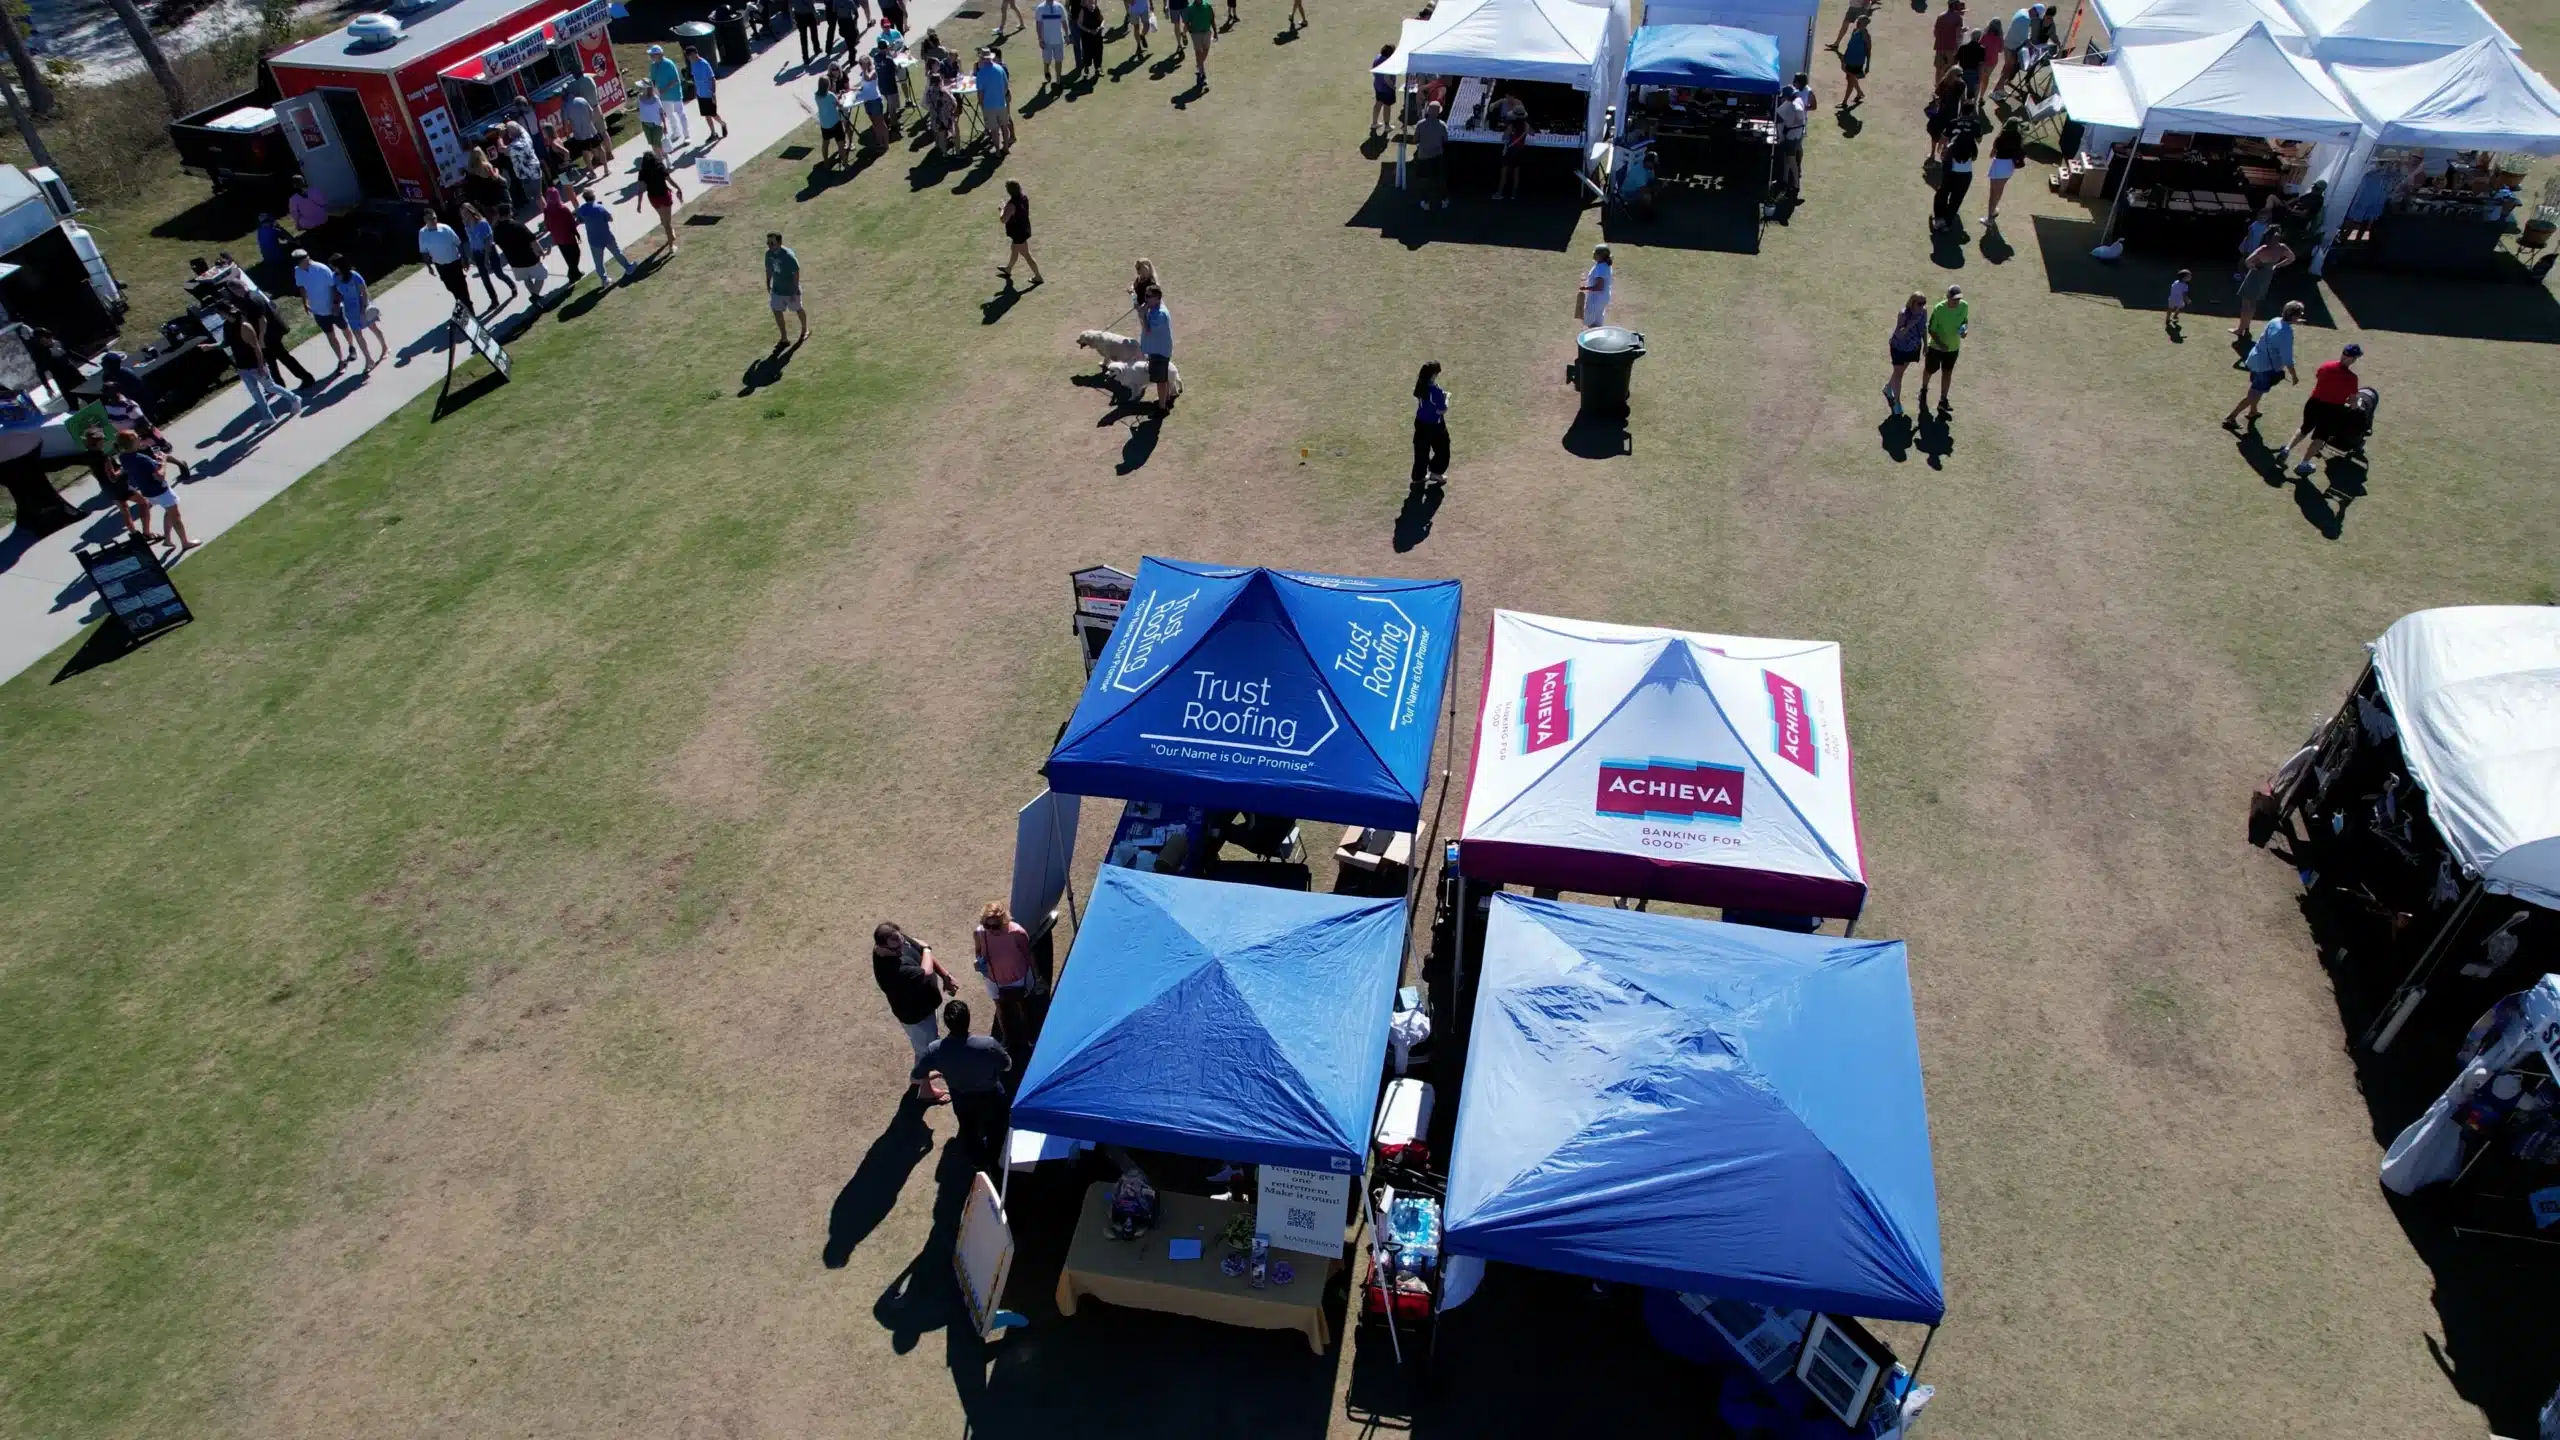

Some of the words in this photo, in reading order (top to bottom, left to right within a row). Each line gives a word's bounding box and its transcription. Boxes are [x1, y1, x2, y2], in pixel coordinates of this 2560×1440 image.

[1124, 600, 1176, 673] Roofing
[1161, 588, 1199, 644] Trust
[1334, 621, 1372, 677] Trust
[1362, 621, 1409, 698] Roofing
[1194, 671, 1272, 706] Trust
[1406, 683, 1420, 708] Name
[1413, 660, 1424, 675] Our
[1182, 701, 1298, 748] Roofing
[1537, 672, 1560, 745] ACHIEVA
[1780, 685, 1800, 760] ACHIEVA
[1181, 747, 1217, 761] Name
[1220, 751, 1229, 762] is
[1232, 752, 1256, 765] Our
[1608, 775, 1733, 806] ACHIEVA
[1642, 827, 1707, 843] BANKING
[1713, 836, 1741, 847] FOR
[1265, 1186, 1294, 1198] Make
[1271, 1165, 1290, 1173] You
[1292, 1168, 1317, 1180] only
[1319, 1175, 1336, 1183] get
[1292, 1177, 1312, 1185] one
